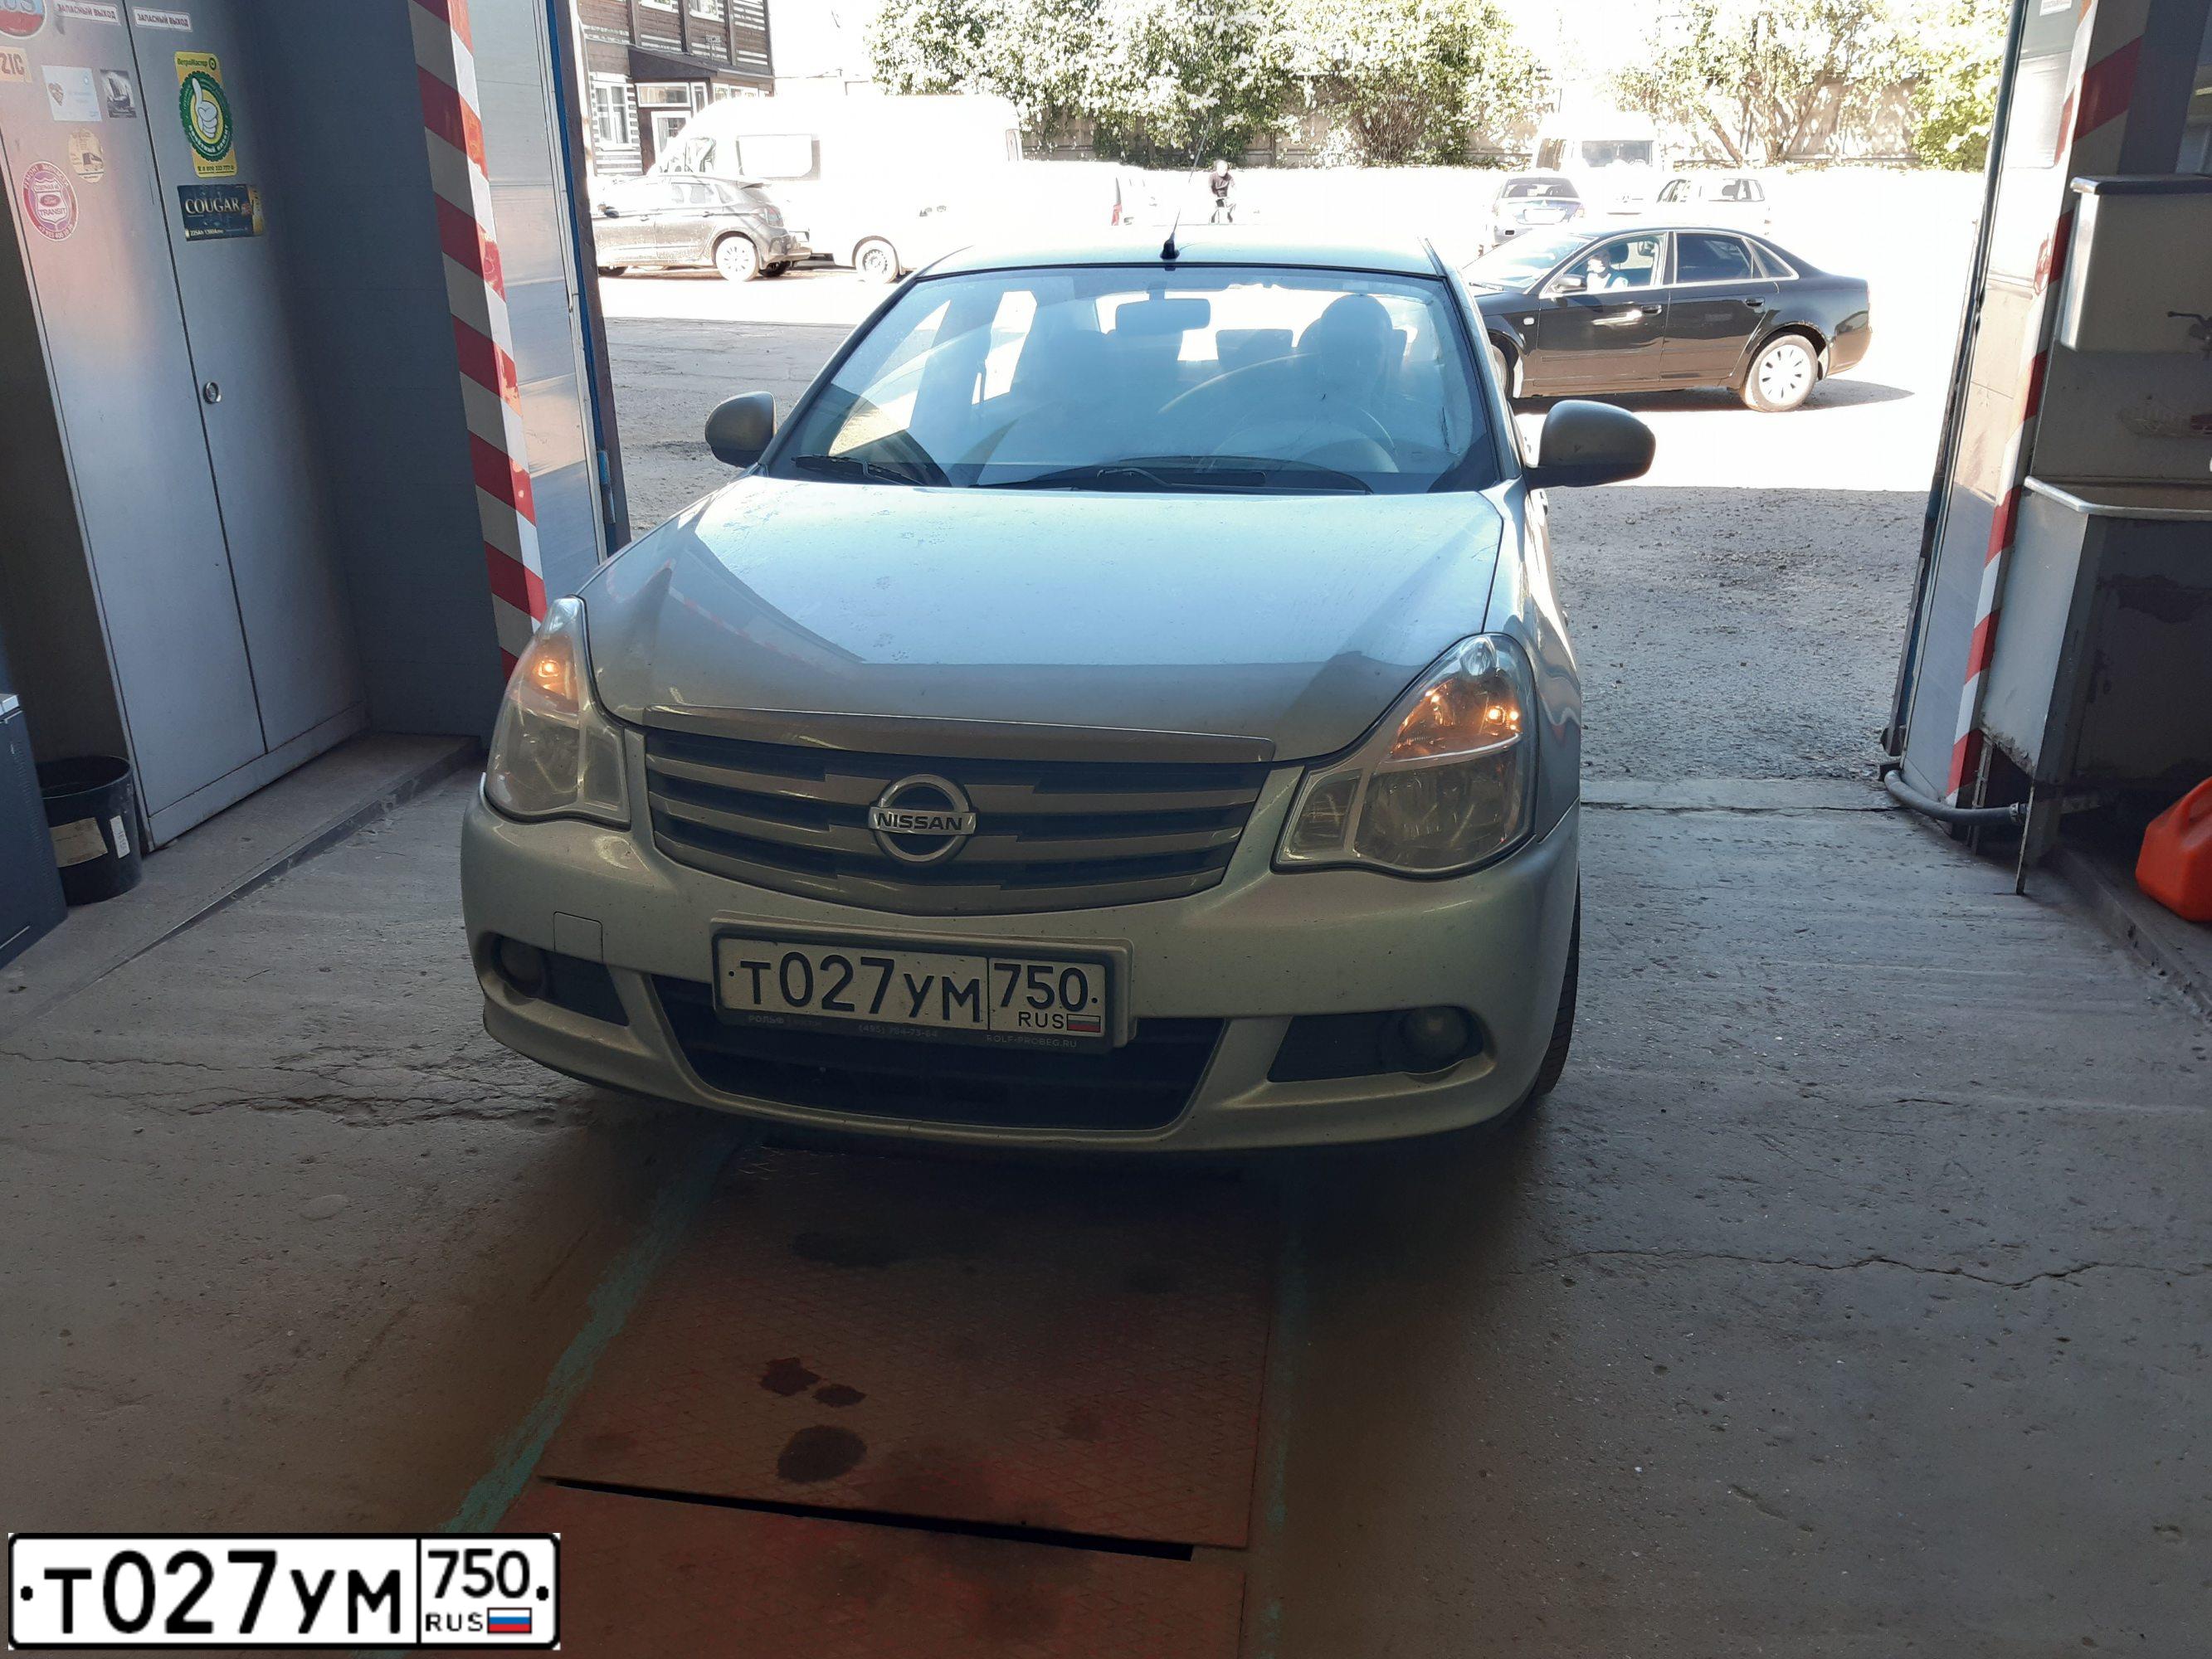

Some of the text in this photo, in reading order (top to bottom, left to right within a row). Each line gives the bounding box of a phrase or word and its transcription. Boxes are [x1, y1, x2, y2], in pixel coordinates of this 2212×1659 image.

[57, 3, 117, 20] ЗАПАСНЫЙ ВЫХОД
[137, 12, 190, 27] ЗАПАСНЫЙ ВЫХОД
[38, 207, 66, 216] TRANSIT
[185, 198, 241, 215] COUGAR
[877, 813, 962, 830] NISSAN
[995, 962, 1089, 1011] 750
[748, 1014, 784, 1024] РОЛЬФ
[1017, 1011, 1065, 1029] RUS
[986, 1034, 1078, 1048] ROLF-PROBEG.RU
